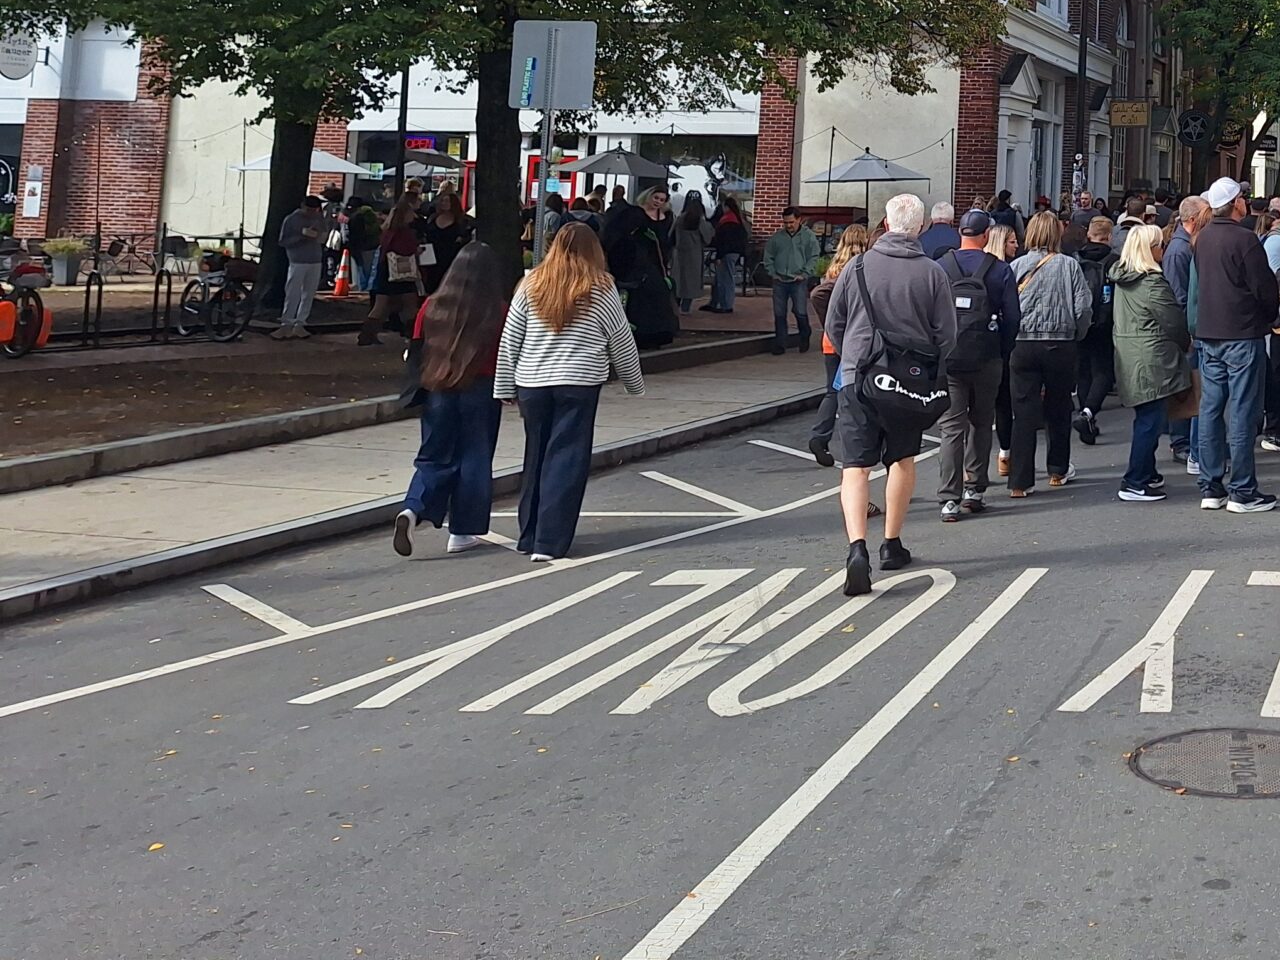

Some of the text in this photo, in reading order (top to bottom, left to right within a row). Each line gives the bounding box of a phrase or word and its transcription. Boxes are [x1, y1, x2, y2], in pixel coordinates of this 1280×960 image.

[404, 138, 433, 149] OPEN
[874, 374, 948, 407] Champion
[287, 568, 957, 718] ONLY
[1228, 746, 1258, 778] DRAIN
